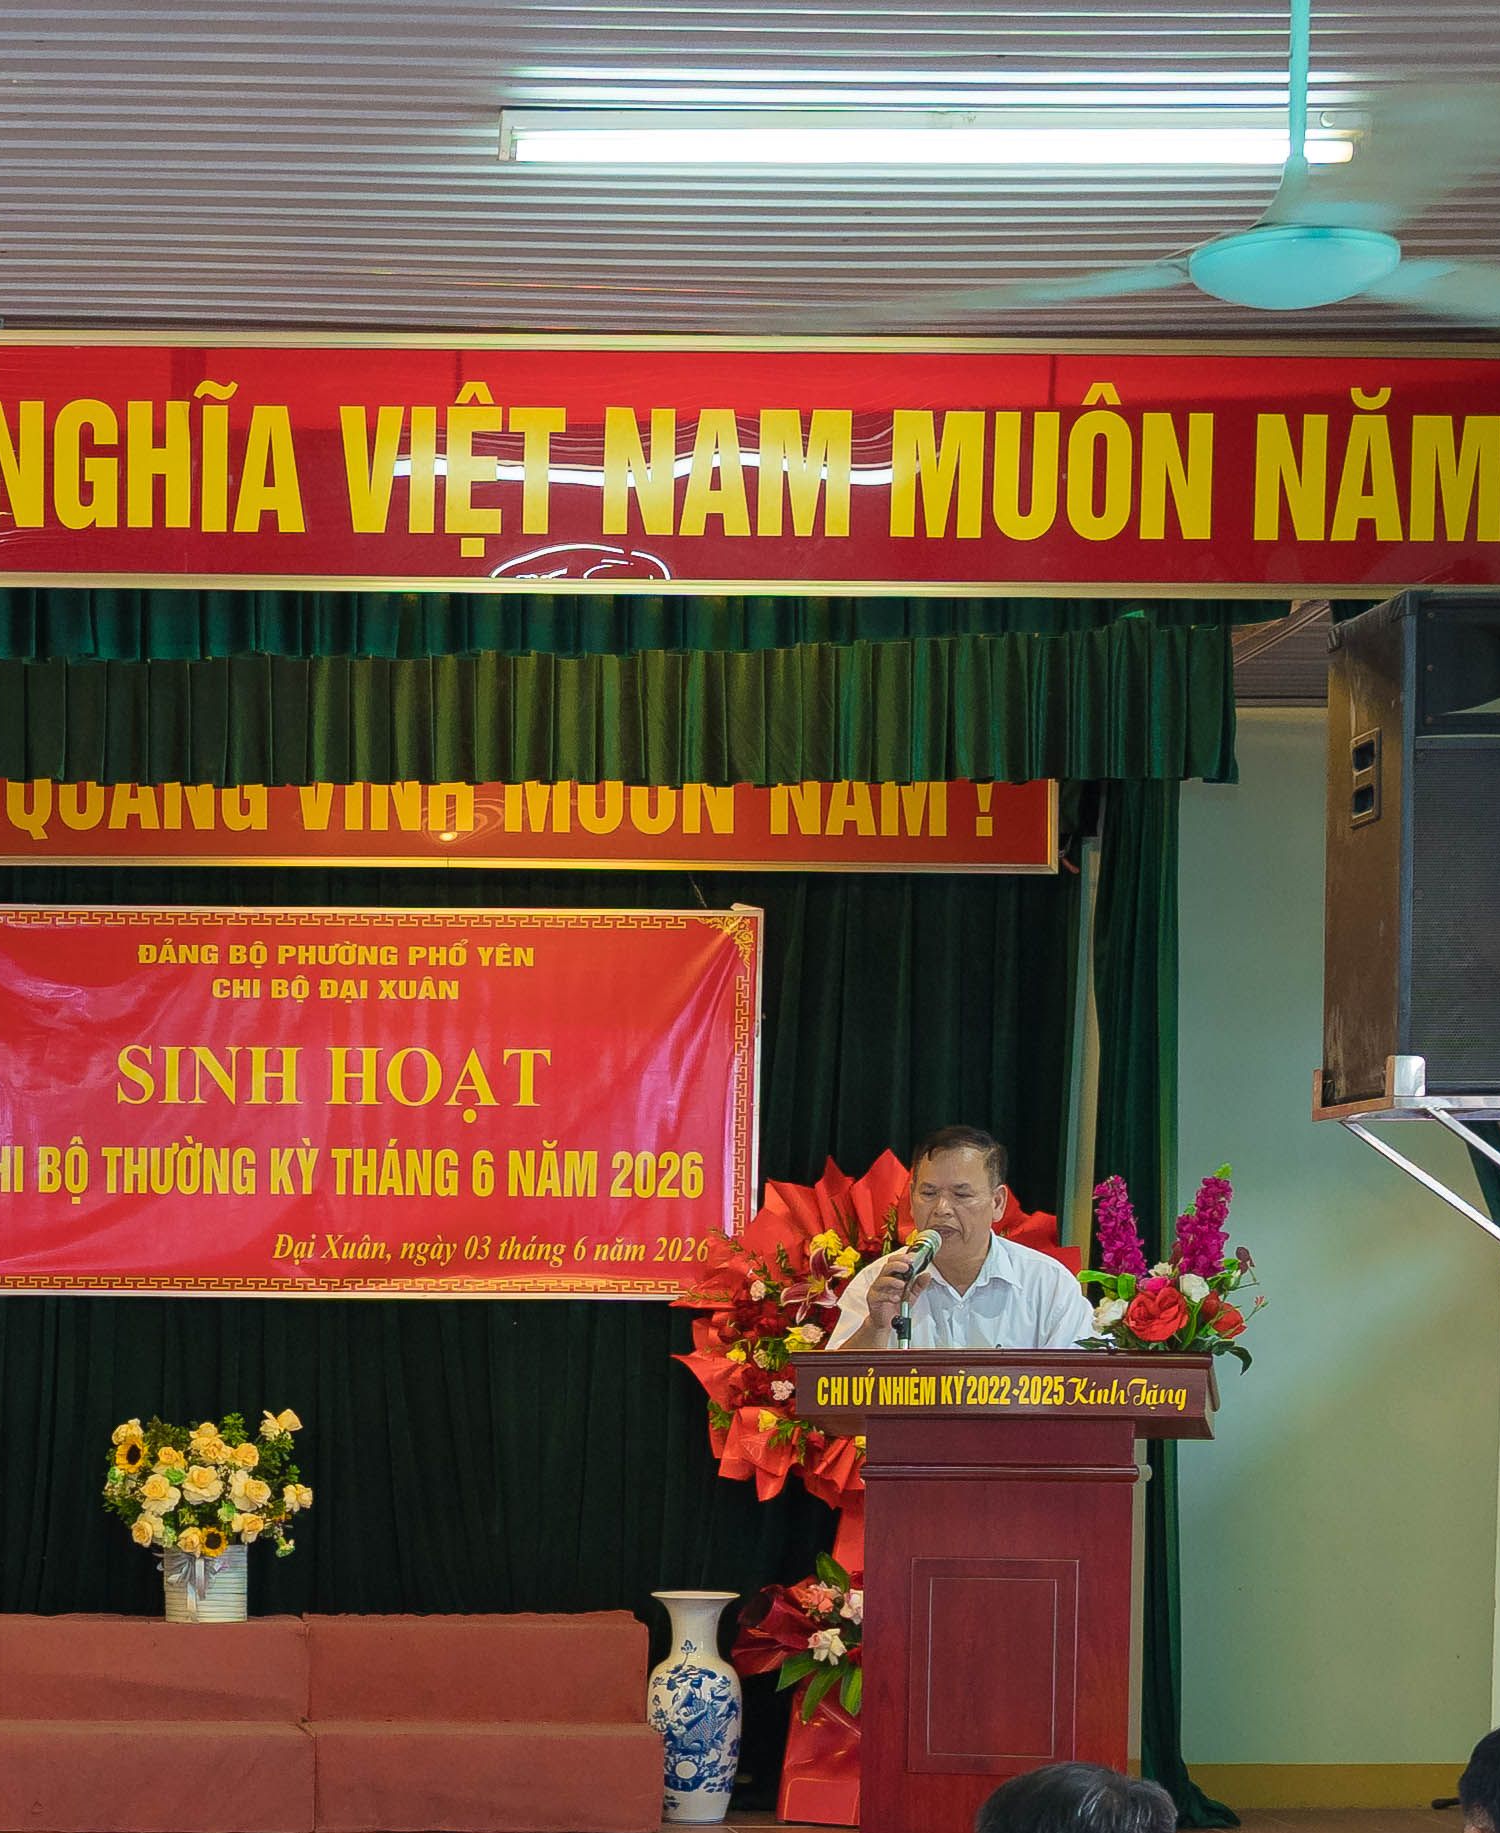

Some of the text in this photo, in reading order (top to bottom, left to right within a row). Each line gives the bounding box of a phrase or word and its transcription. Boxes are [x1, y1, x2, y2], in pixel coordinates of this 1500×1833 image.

[340, 381, 566, 558] VIỆT
[602, 407, 852, 537] NAM
[889, 382, 1214, 542] MUÔN
[138, 938, 535, 968] ĐẢNG BỘ PHƯỜNG PHỔ YÊN
[212, 975, 460, 1003] CHI BỘ ĐẠI XUÂN
[116, 1045, 551, 1123] SINH HOẠT
[39, 1136, 88, 1204] BỘ
[101, 1135, 256, 1195] THƯỜNG
[270, 1138, 319, 1194] KỲ
[331, 1137, 459, 1197] THÁNG
[472, 1150, 495, 1197] 6
[508, 1139, 597, 1197] NĂM
[610, 1151, 704, 1198] 2026
[272, 1234, 709, 1267] Đại Xuân, ngày 03 tháng 6 năm 2026
[816, 1376, 849, 1406] CHI
[852, 1367, 876, 1406] UỶ
[1066, 1377, 1129, 1406] Kính
[1127, 1378, 1188, 1411] Tặng
